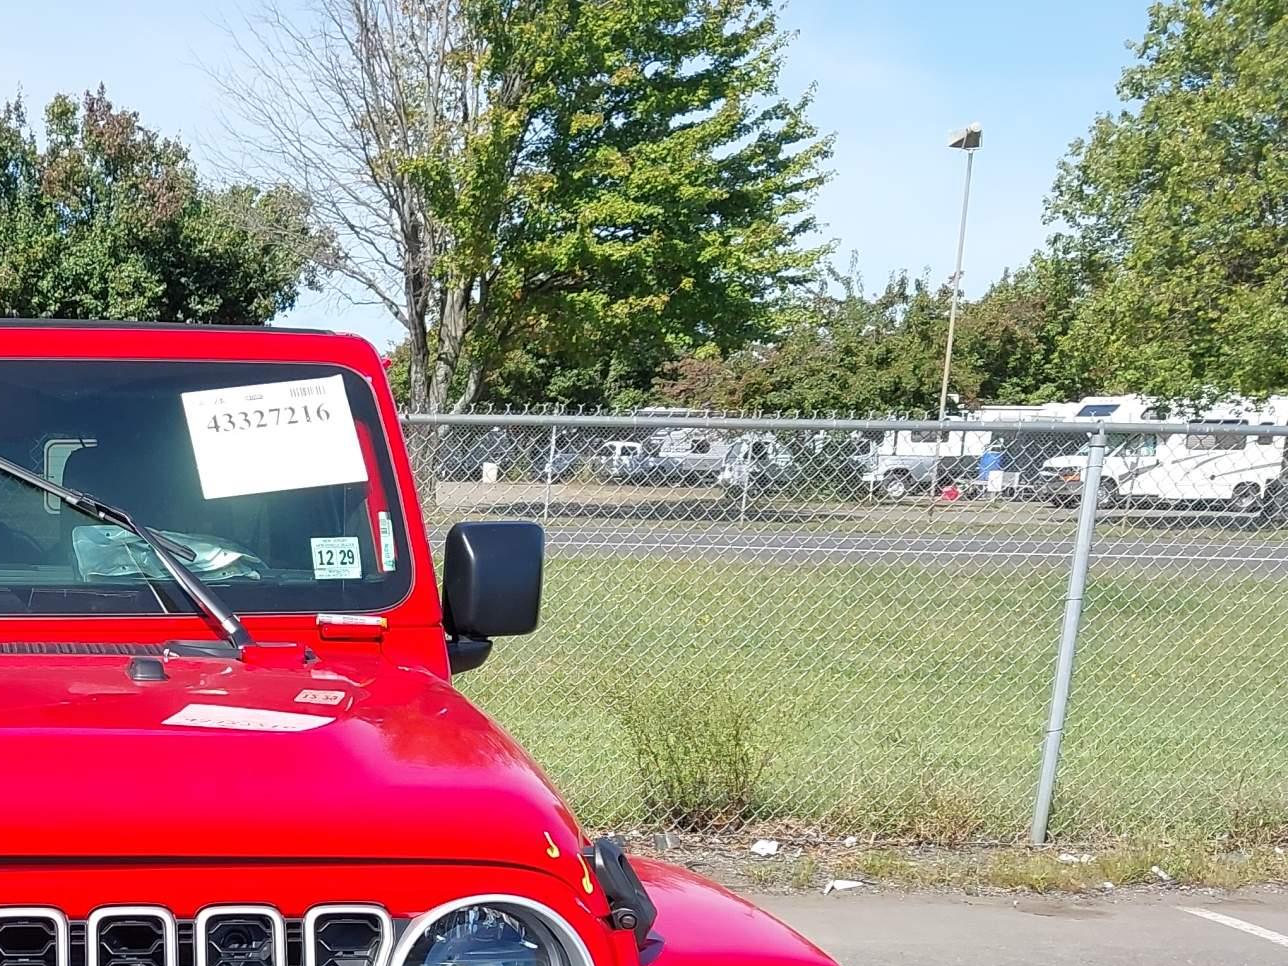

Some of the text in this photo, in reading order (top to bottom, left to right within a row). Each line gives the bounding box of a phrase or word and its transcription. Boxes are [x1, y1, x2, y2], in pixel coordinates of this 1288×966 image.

[207, 402, 330, 433] 43327216
[317, 549, 355, 566] 12 29
